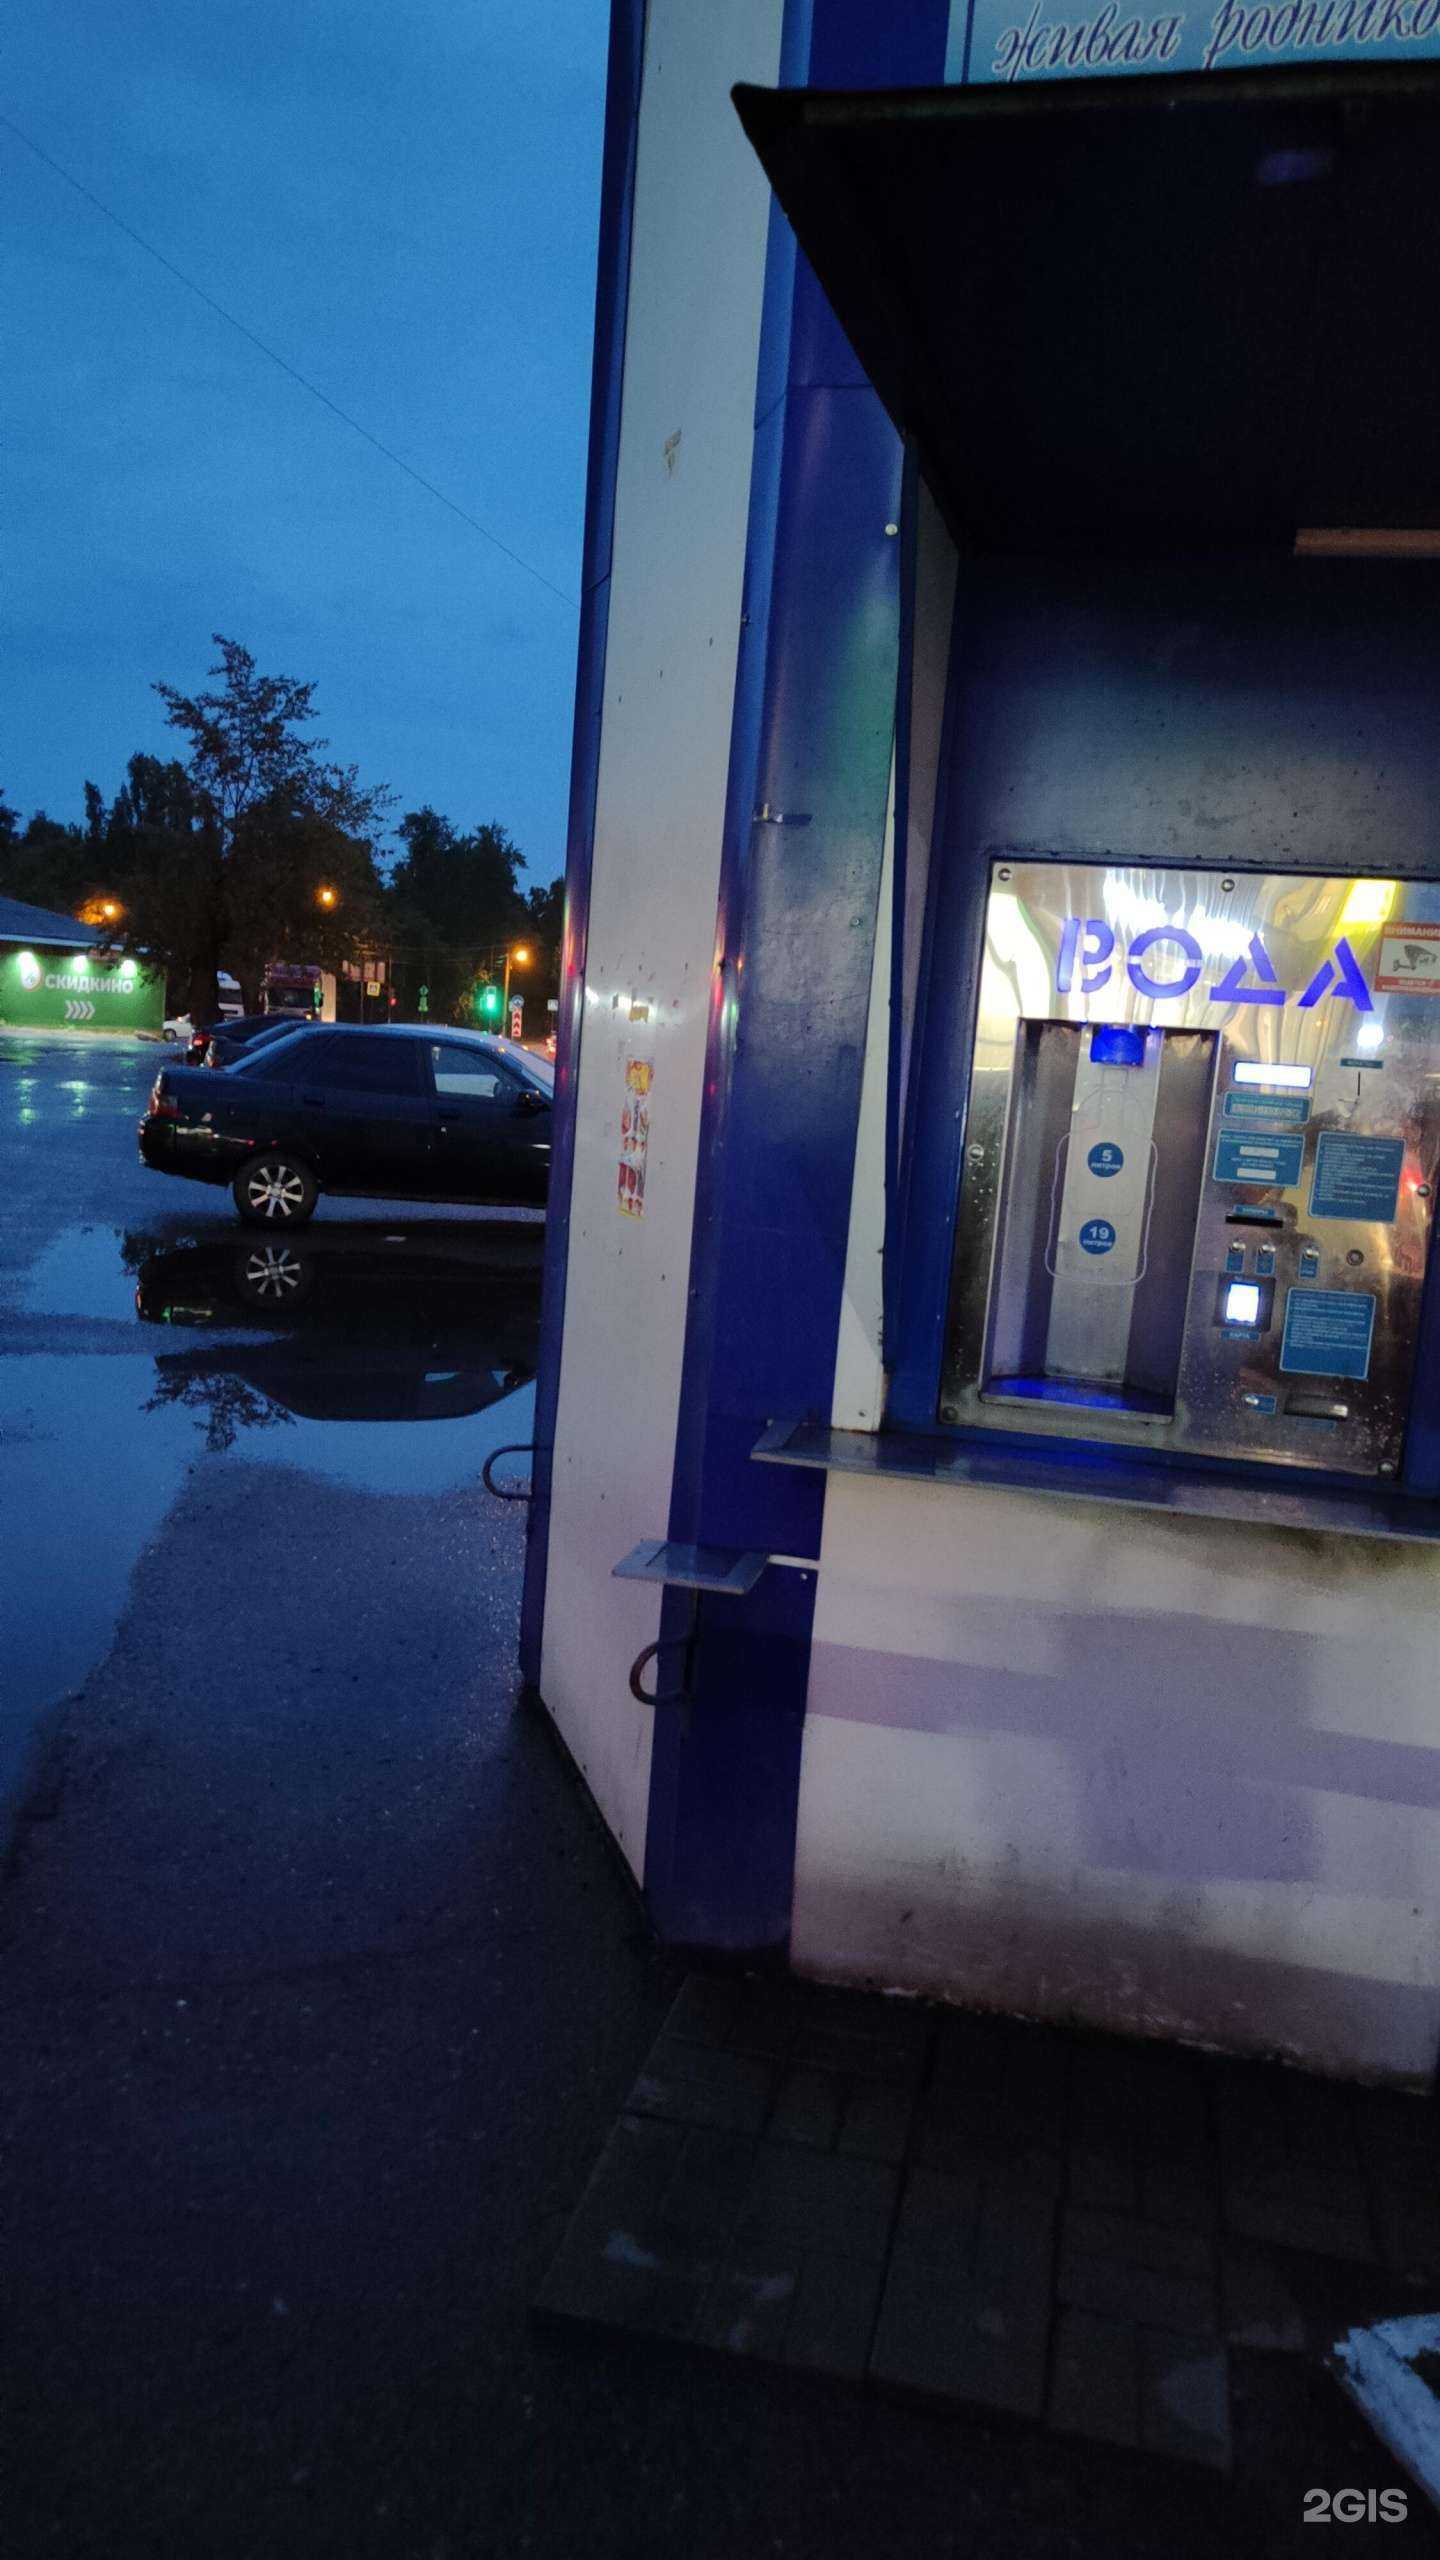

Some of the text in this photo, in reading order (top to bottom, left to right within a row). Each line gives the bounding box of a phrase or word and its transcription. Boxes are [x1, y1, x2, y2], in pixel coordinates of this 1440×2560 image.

[993, 1, 1183, 82] живая
[1057, 918, 1374, 1012] ВОДА
[45, 973, 134, 995] СКИДКИНО
[1102, 1149, 1113, 1162] 5
[1089, 1226, 1110, 1240] 19
